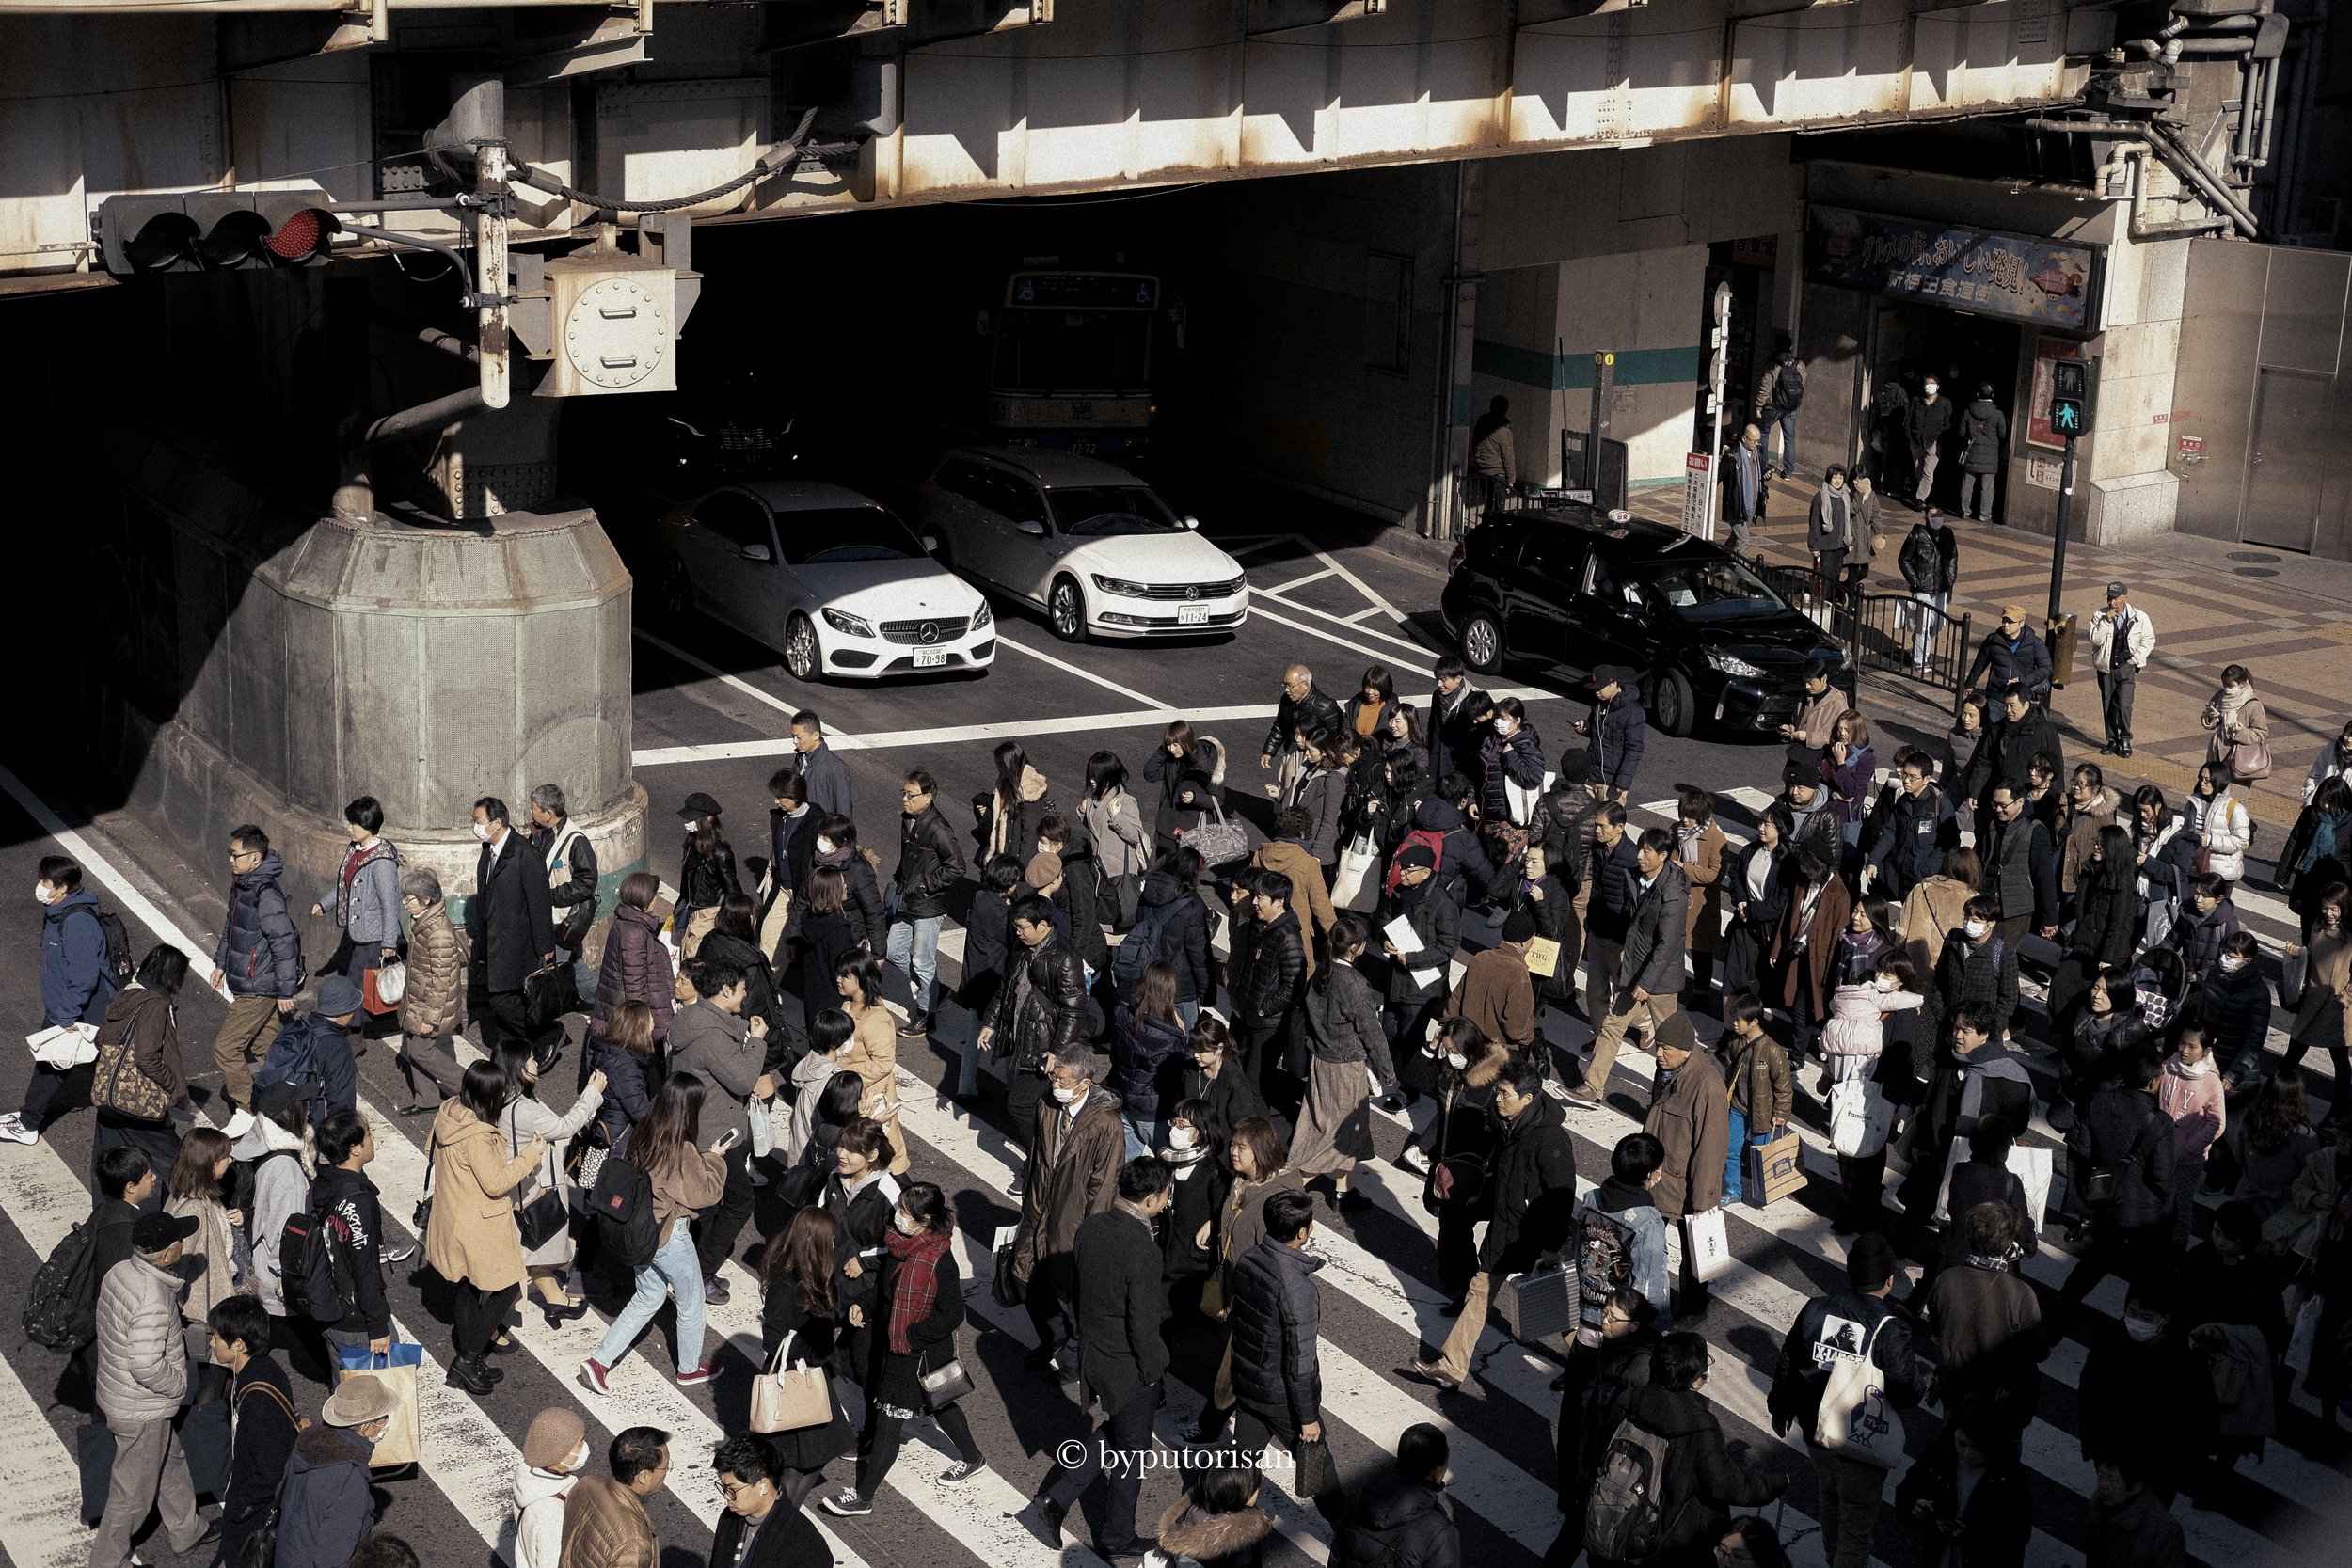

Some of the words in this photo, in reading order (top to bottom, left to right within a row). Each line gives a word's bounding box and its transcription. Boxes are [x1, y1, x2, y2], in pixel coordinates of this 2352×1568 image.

[1888, 269, 1994, 304] 新梅田食道街
[921, 654, 946, 665] 70-98
[1531, 951, 1548, 961] TWG
